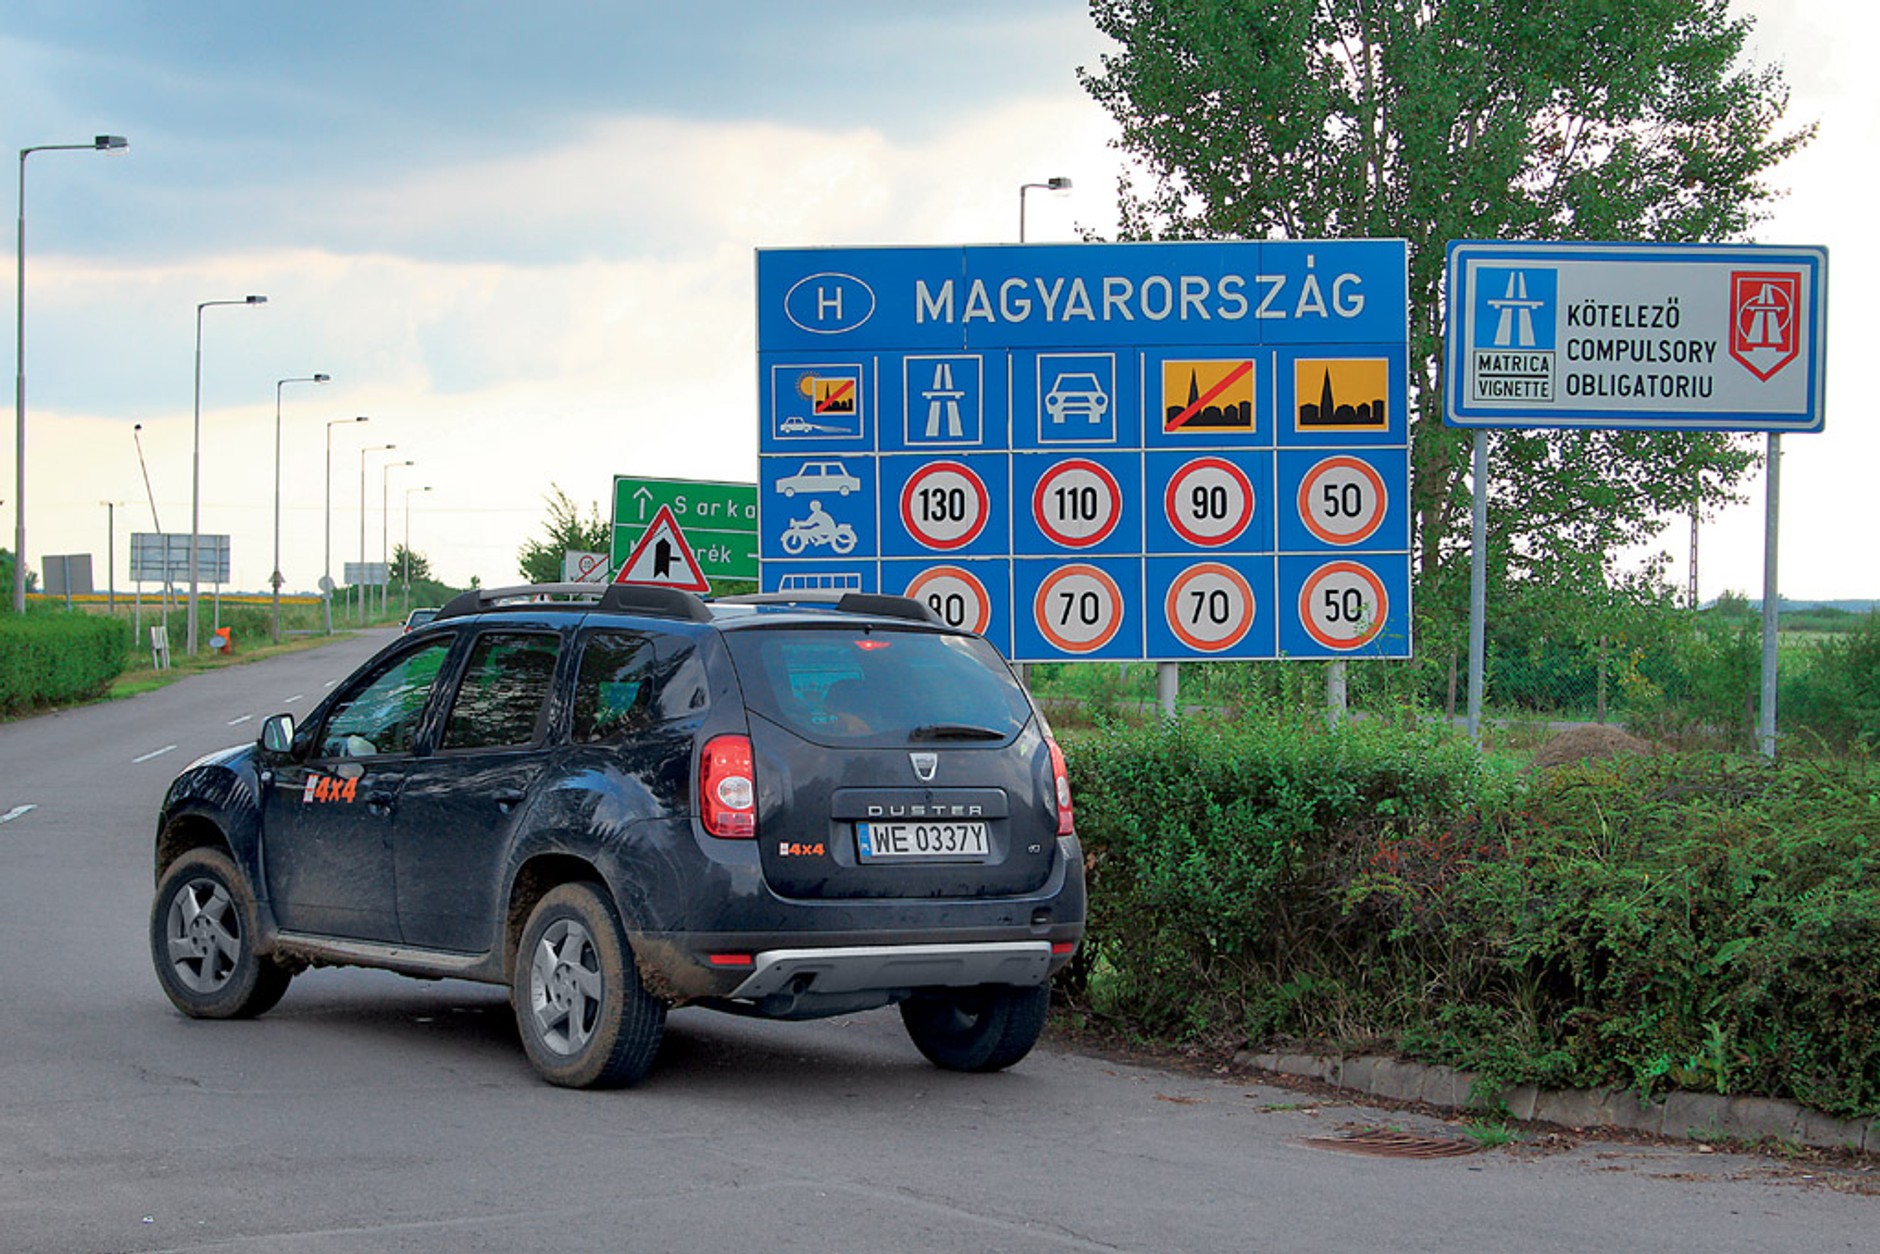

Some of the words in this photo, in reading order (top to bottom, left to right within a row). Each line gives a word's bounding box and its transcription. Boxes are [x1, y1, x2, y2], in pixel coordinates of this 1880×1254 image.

[817, 287, 843, 321] H
[915, 255, 1365, 323] MAGYARORSZÁG
[1478, 354, 1549, 372] MATRICA
[1567, 338, 1717, 363] COMPULSORY
[1478, 380, 1549, 398] VIGNETTE
[1566, 373, 1713, 398] OBLIGATORIU
[918, 487, 966, 522] 130
[1054, 486, 1098, 521] 110
[1192, 486, 1228, 520] 90
[1323, 483, 1363, 517] 50
[1059, 591, 1099, 625] 70
[1190, 590, 1230, 624] 70
[1325, 588, 1363, 622] 50
[315, 776, 358, 803] 4x4
[868, 805, 982, 816] DUSTER
[789, 843, 825, 856] 4x4
[873, 826, 909, 853] WE
[915, 825, 982, 852] 0337Y
